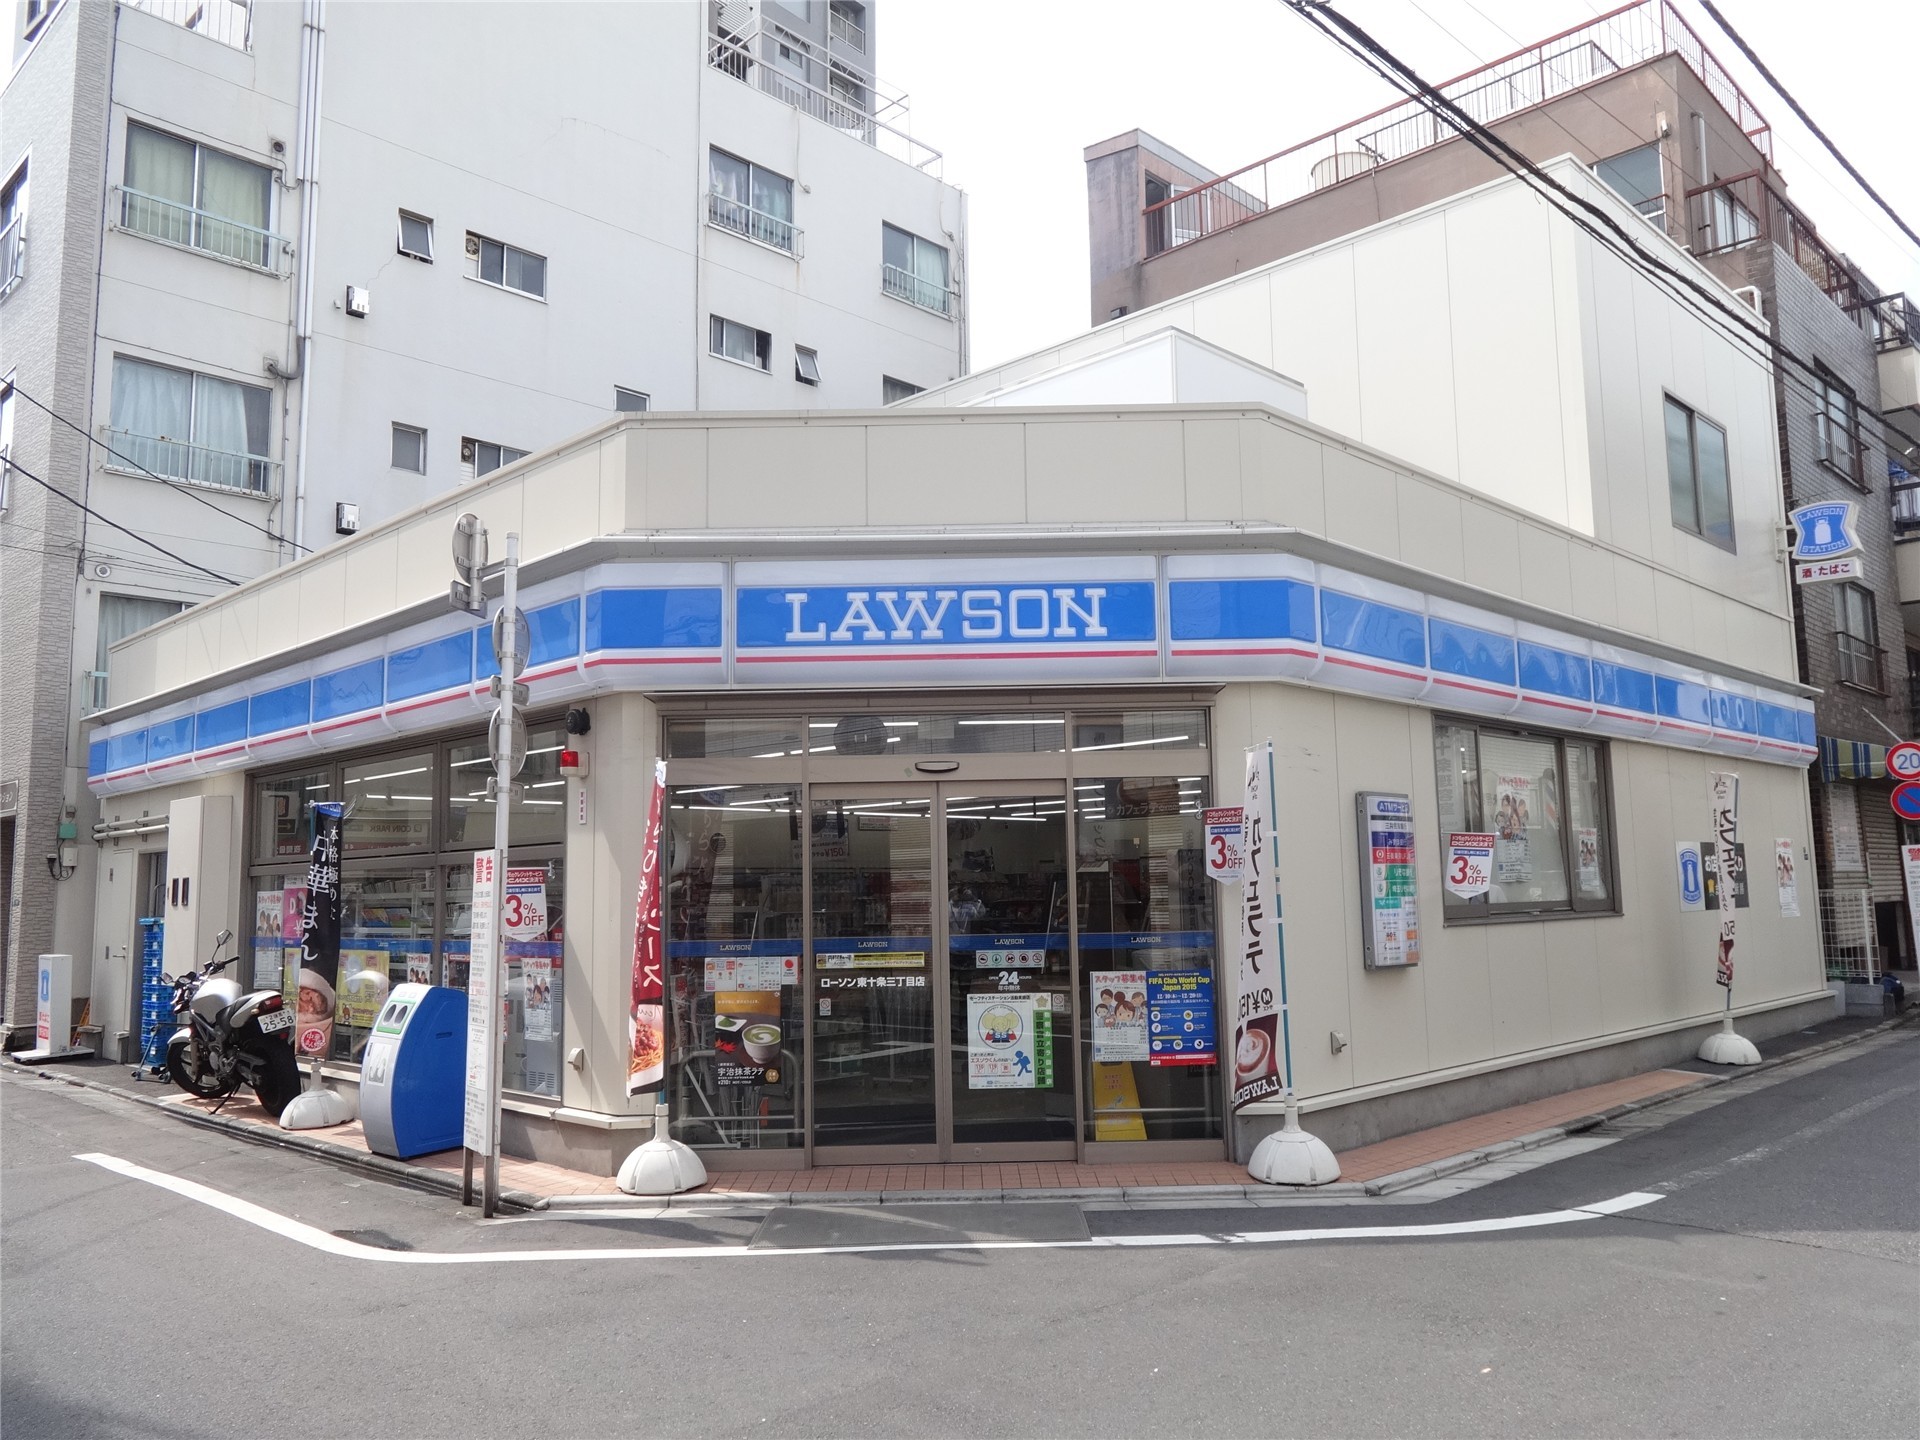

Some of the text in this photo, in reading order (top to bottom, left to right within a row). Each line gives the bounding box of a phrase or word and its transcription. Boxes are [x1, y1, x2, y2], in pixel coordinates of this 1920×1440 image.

[1799, 508, 1844, 521] LAWSON
[1802, 540, 1847, 553] STATION
[785, 588, 1108, 641] LAWSON
[1896, 752, 1920, 770] 20
[1227, 857, 1242, 869] OFF
[1467, 876, 1488, 886] OFF
[523, 914, 545, 926] OFF
[998, 971, 1020, 985] 24
[1197, 976, 1210, 984] Cup
[718, 1067, 765, 1076] 宇治抹茶ラテ
